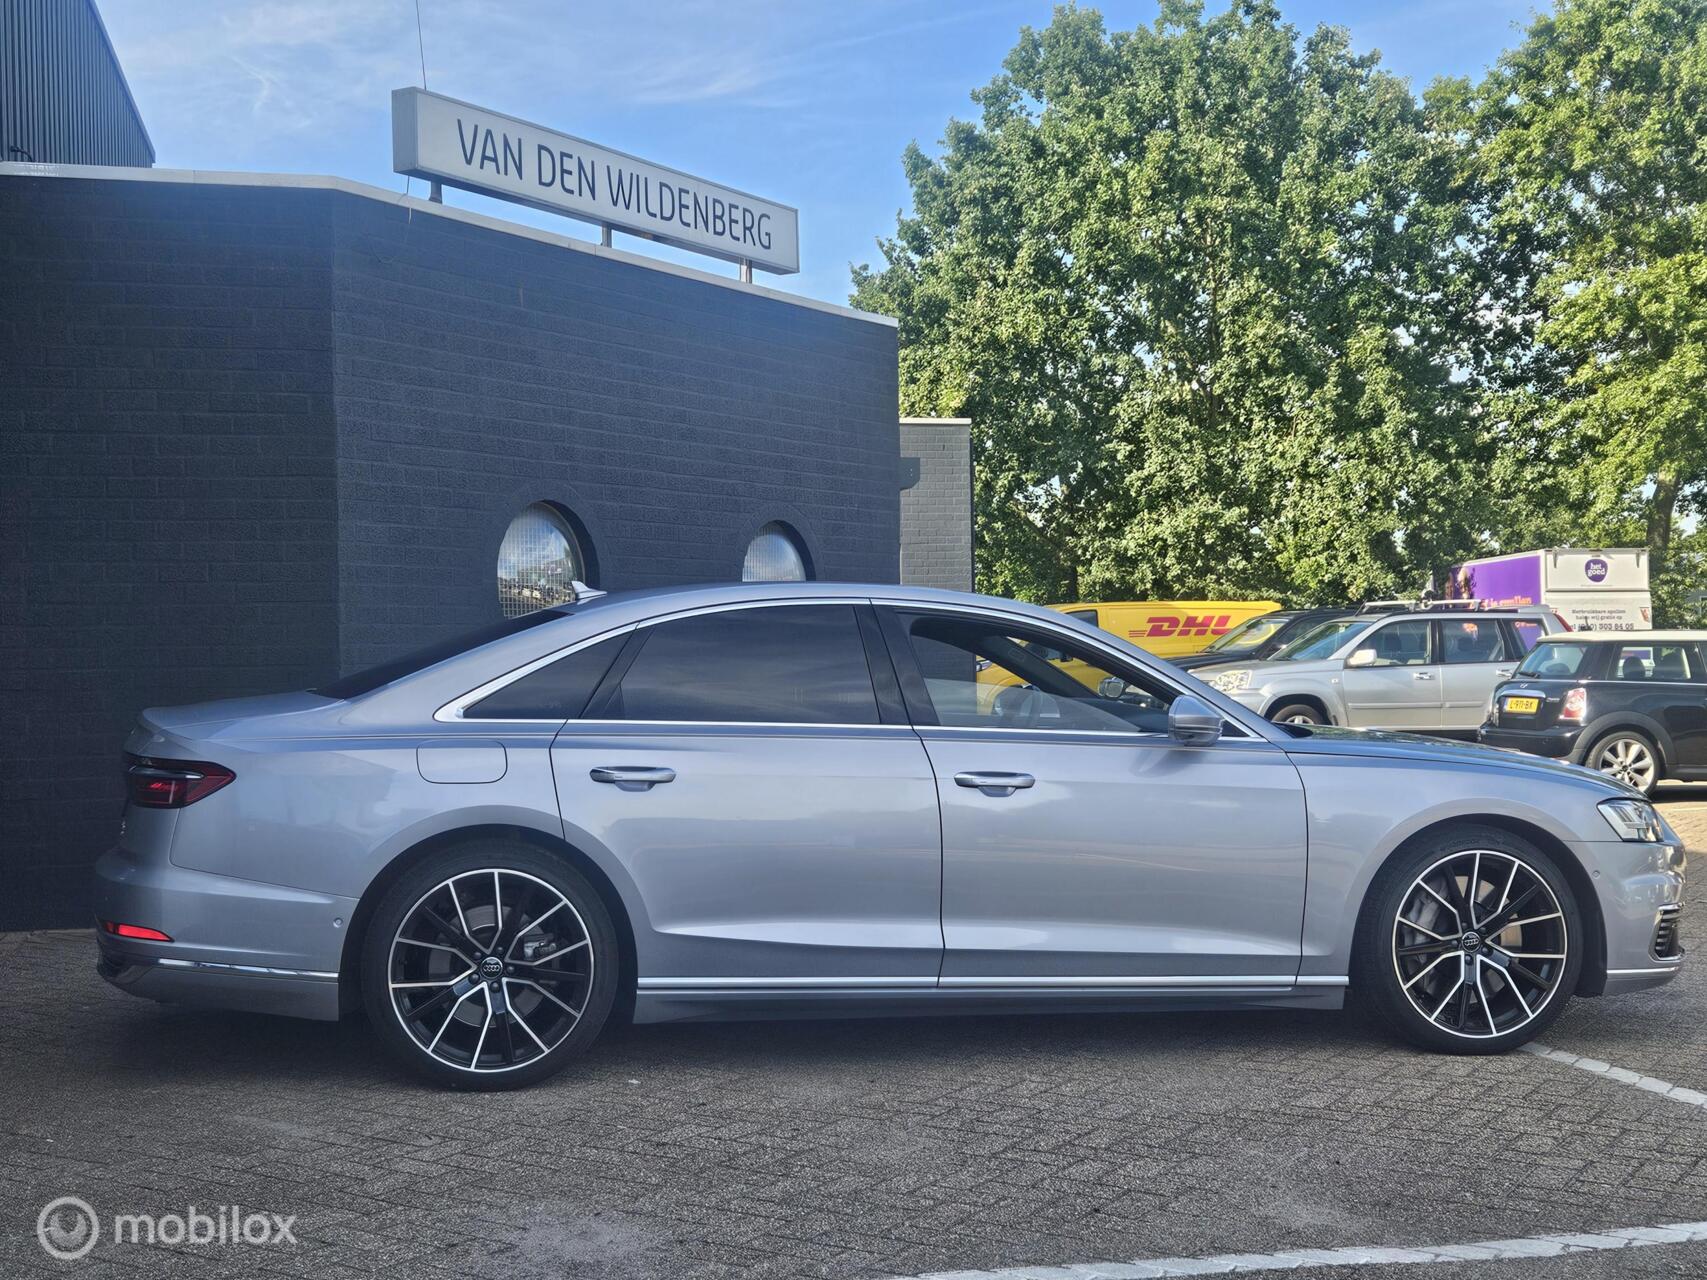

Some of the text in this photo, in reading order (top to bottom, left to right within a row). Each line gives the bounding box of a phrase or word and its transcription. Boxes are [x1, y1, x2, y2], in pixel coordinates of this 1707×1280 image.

[457, 118, 772, 250] VAN DEN WILDENBERG
[1587, 568, 1606, 577] goed
[1590, 562, 1602, 570] het
[1146, 615, 1233, 637] DHL
